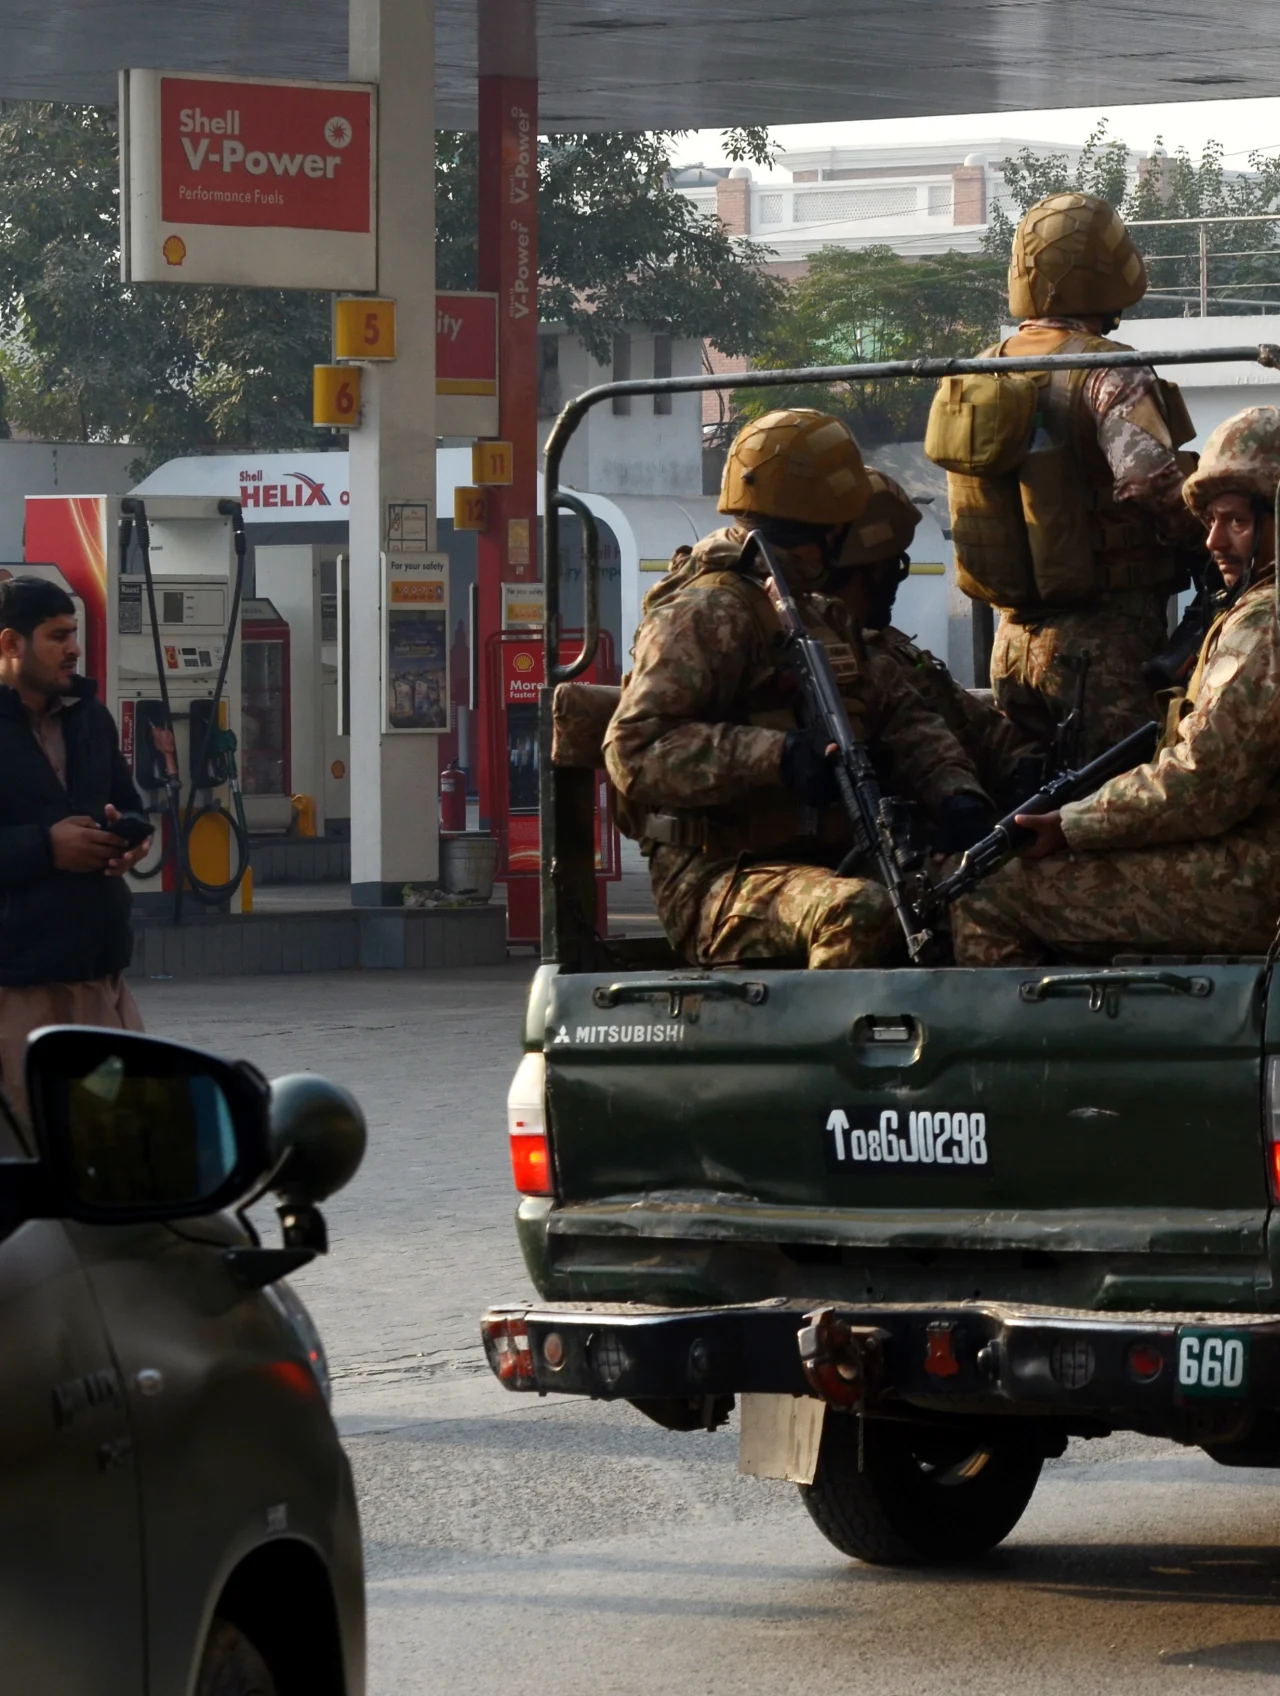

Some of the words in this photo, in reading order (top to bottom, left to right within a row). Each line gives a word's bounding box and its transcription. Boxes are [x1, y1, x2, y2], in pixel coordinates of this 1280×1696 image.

[179, 107, 240, 135] Shell
[180, 137, 342, 179] V-Power
[514, 108, 530, 204] V-Power
[179, 186, 251, 203] Performance
[254, 190, 284, 204] Fuels
[514, 222, 530, 319] V-Power
[363, 313, 380, 346] 5
[335, 382, 355, 415] 6
[239, 470, 263, 482] Shell
[489, 452, 506, 476] 11
[240, 476, 330, 508] HELIX
[466, 498, 486, 522] 12
[391, 561, 403, 570] For
[404, 563, 421, 572] your
[422, 561, 444, 572] safety
[509, 680, 545, 691] More
[509, 691, 536, 699] Faster
[575, 1024, 685, 1043] MITSUBISHI
[1178, 1336, 1244, 1389] 660
